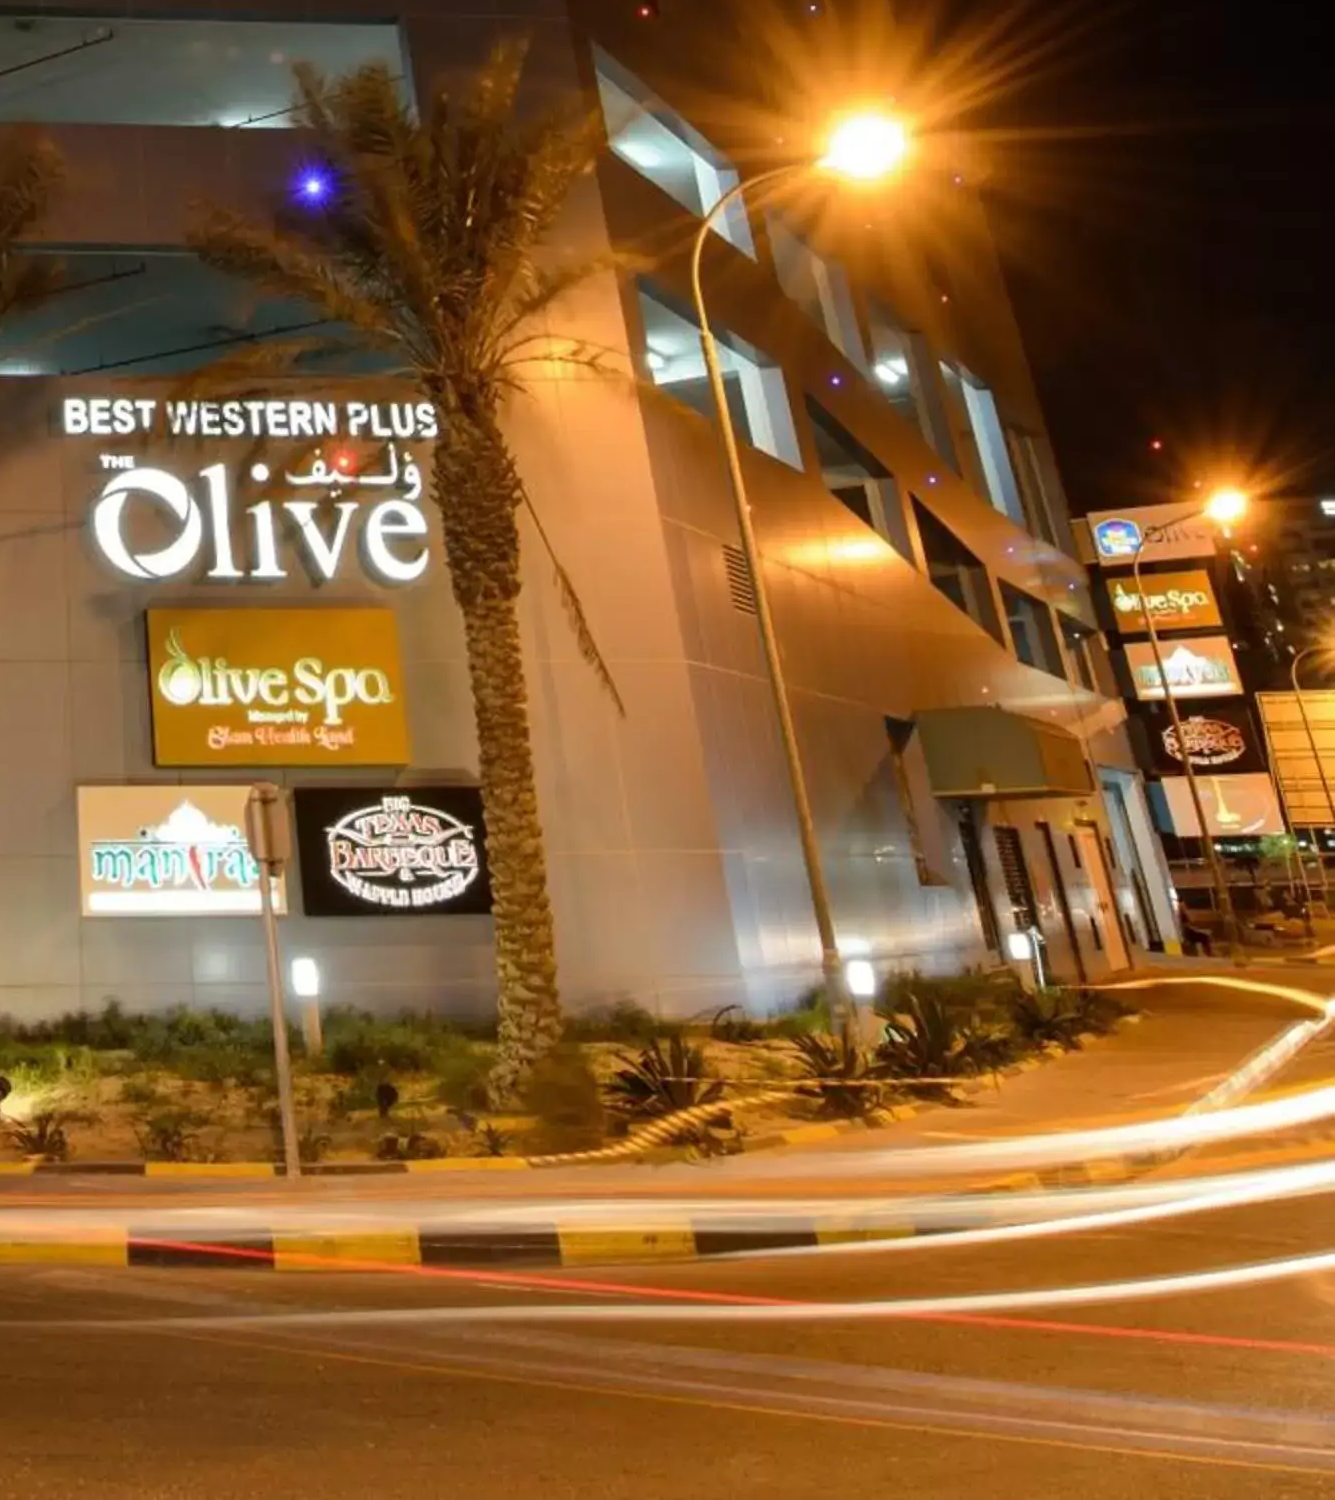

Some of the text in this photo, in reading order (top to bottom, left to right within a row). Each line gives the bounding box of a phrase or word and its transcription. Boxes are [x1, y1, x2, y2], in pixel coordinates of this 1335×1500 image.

[64, 399, 438, 438] BEST WESTERN PLUS
[100, 454, 135, 469] THE
[94, 463, 429, 580] Olive
[158, 656, 393, 725] Olive Spa
